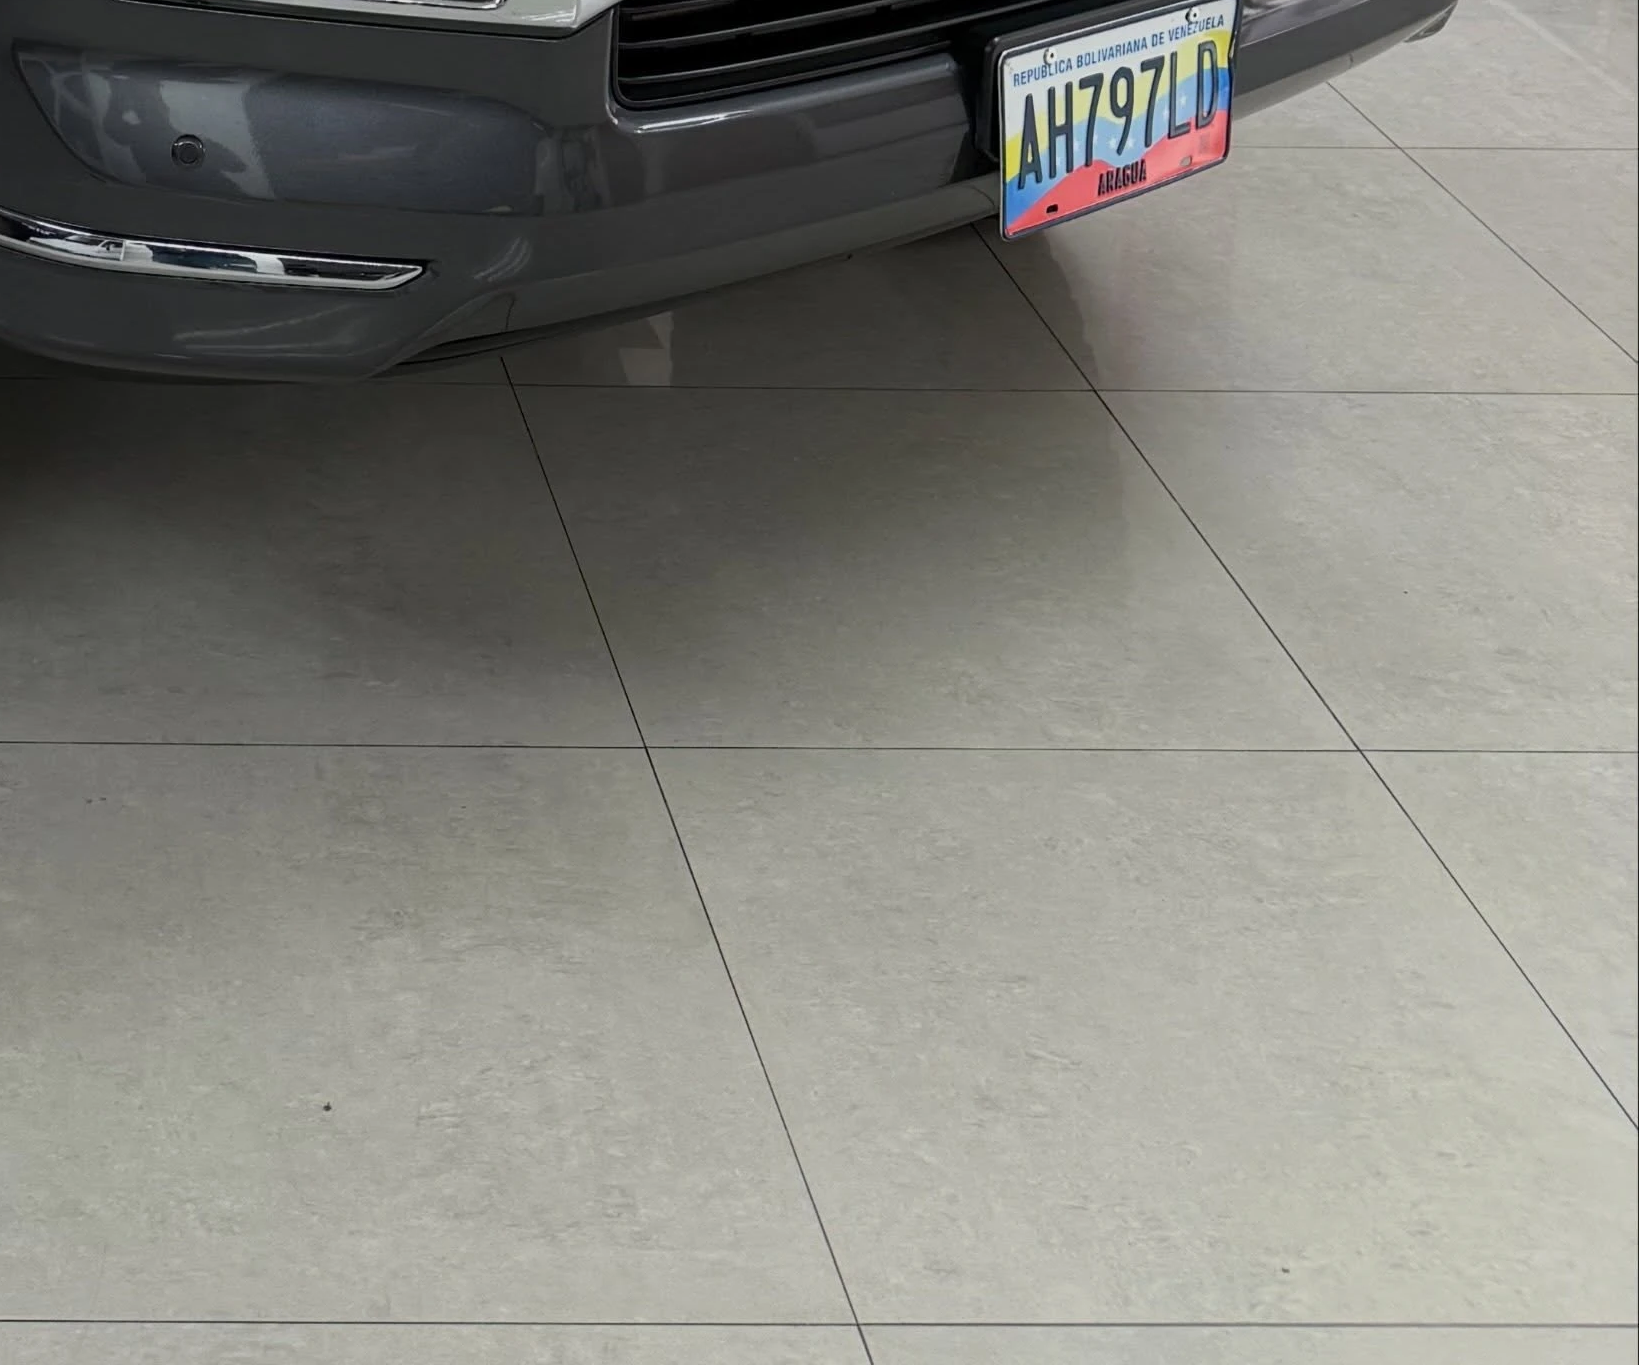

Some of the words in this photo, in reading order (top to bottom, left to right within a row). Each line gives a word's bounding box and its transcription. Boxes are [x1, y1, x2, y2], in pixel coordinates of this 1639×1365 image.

[1013, 59, 1073, 87] REPUBLICA
[1076, 38, 1148, 69] BOLIVARIANA
[1151, 33, 1165, 47] DE
[1167, 14, 1225, 42] VENEZUELA
[1017, 40, 1220, 191] AH797LD
[1097, 158, 1147, 197] ARAGUA
